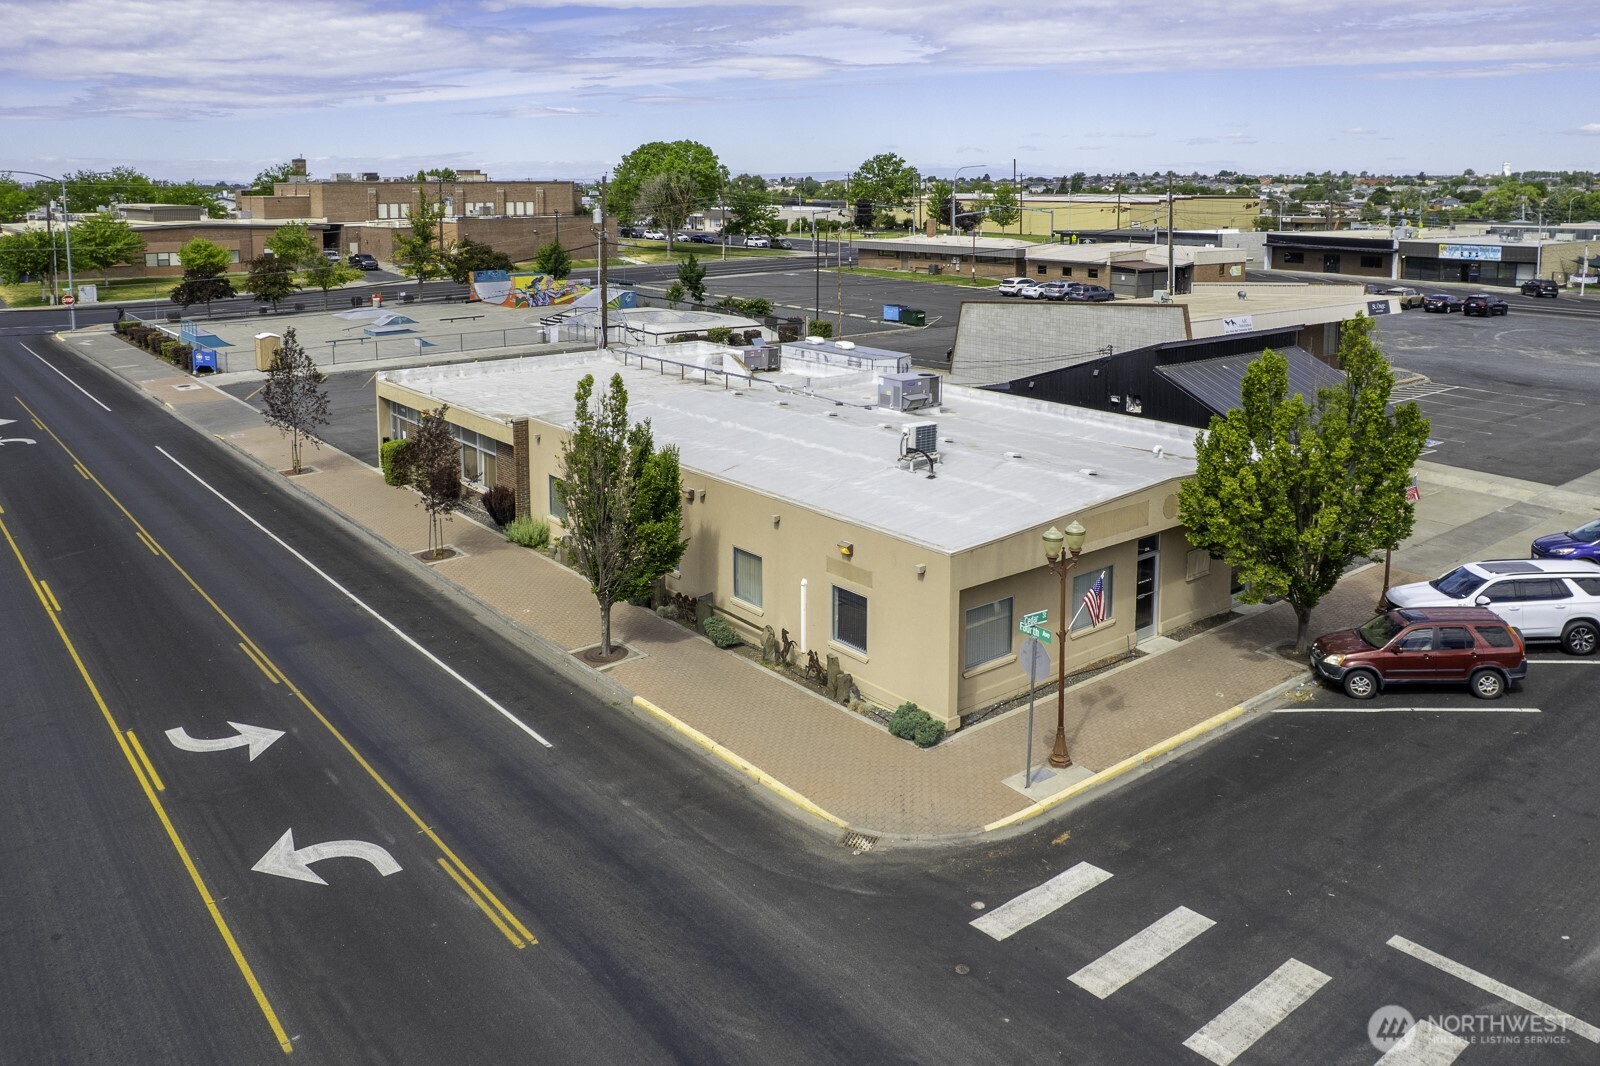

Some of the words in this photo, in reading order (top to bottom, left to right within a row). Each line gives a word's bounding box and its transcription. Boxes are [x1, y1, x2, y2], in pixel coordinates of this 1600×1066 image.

[1024, 615, 1039, 626] Cedar
[1019, 621, 1040, 637] Fourth
[1042, 630, 1051, 639] Ave
